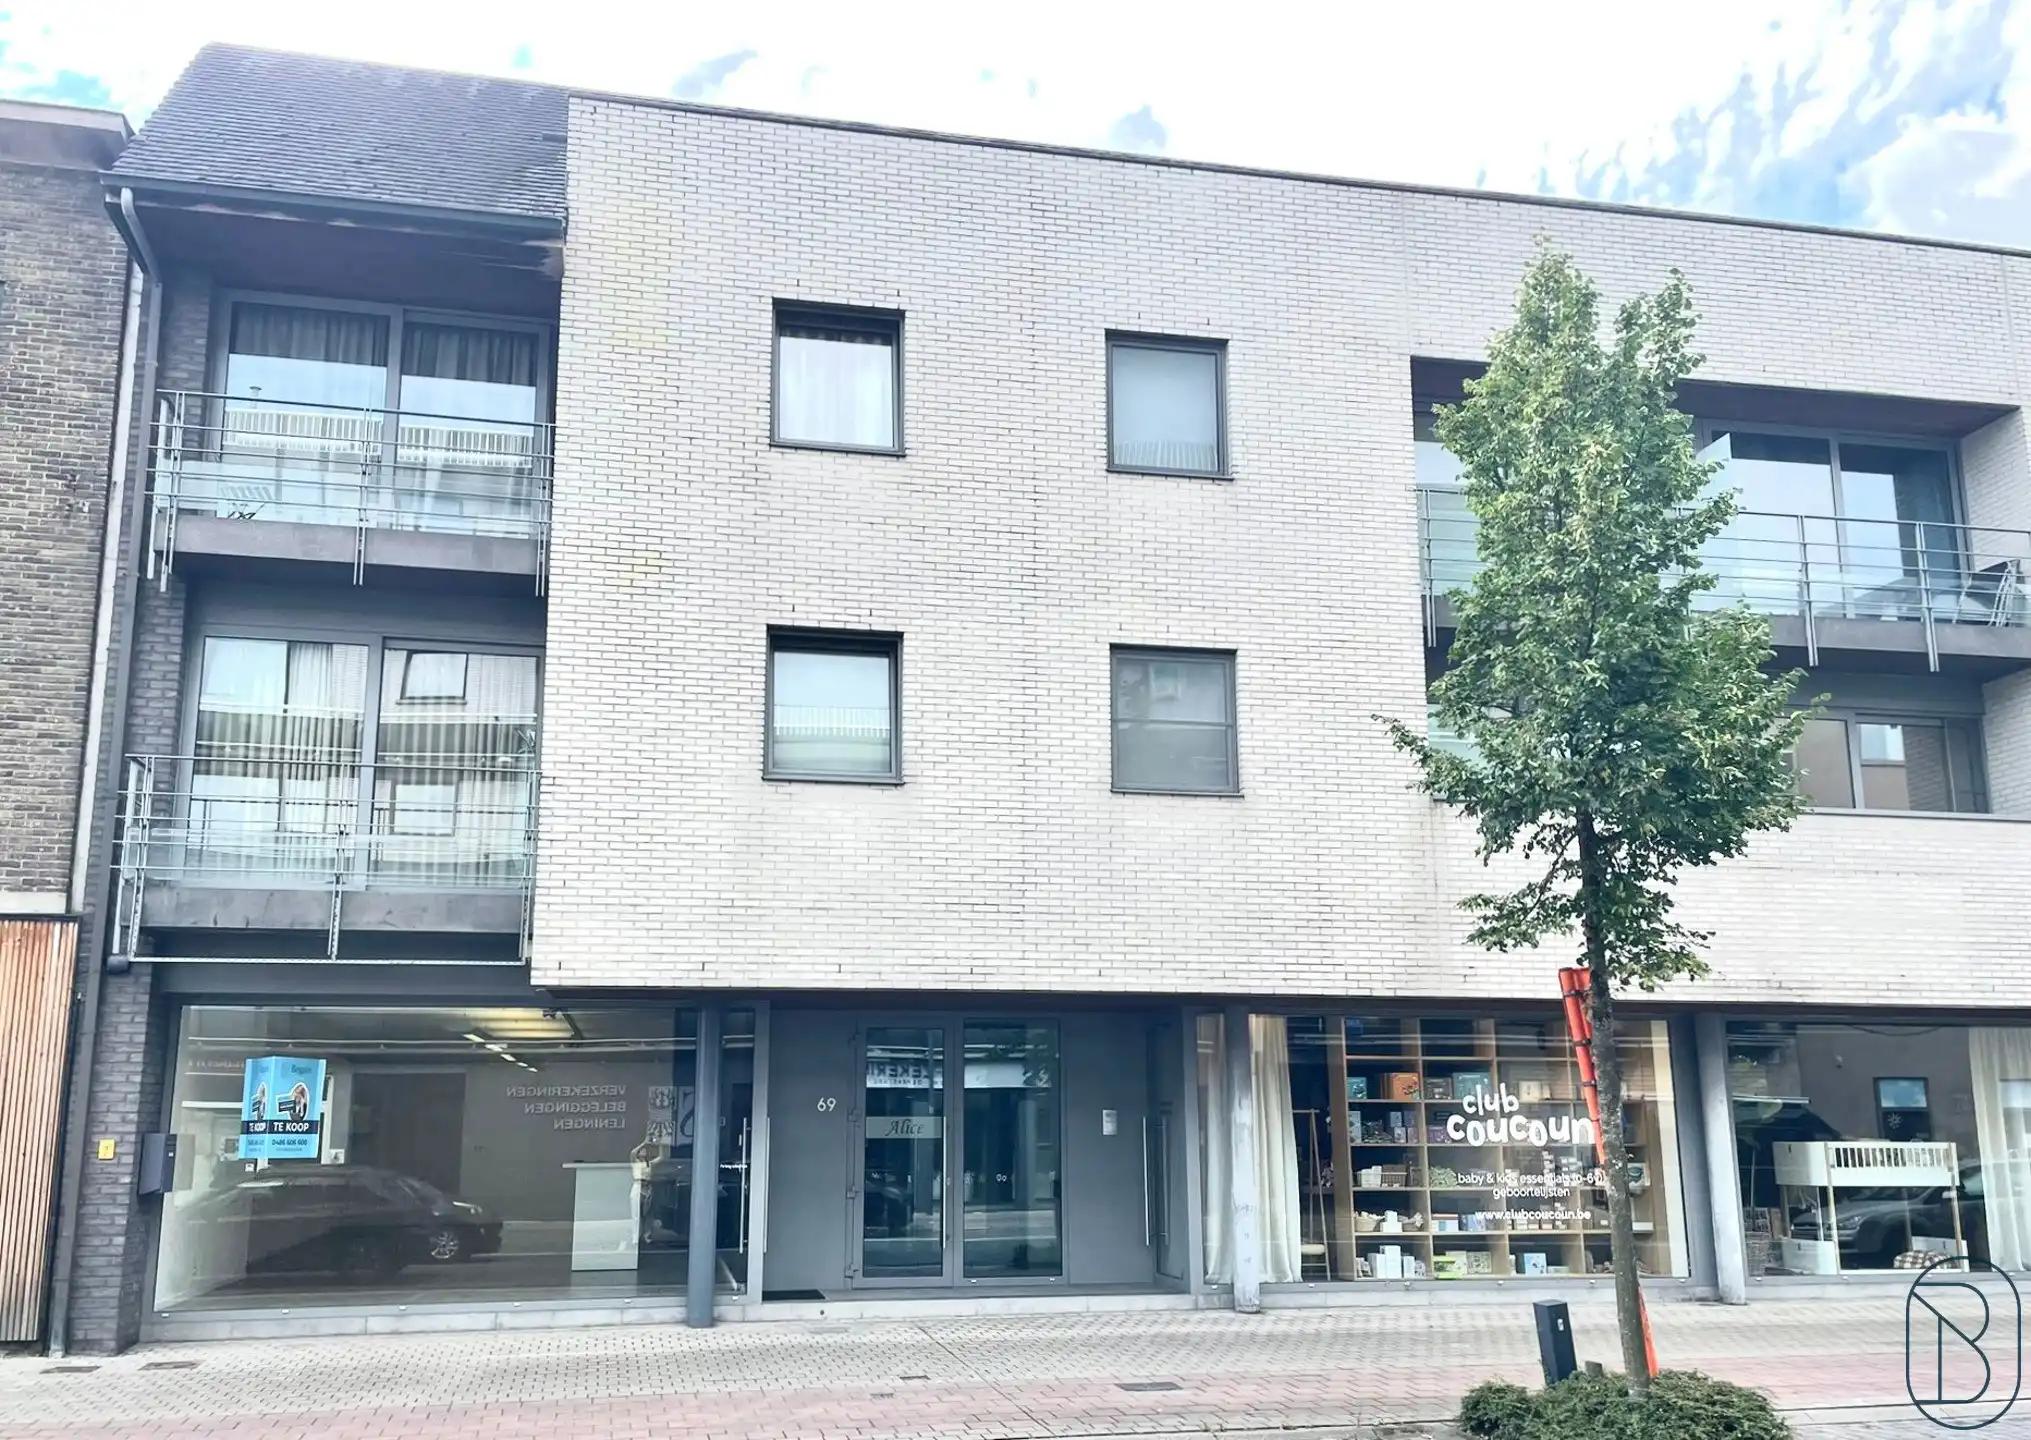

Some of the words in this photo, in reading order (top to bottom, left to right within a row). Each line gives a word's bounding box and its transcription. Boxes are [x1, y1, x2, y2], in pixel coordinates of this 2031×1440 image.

[816, 1097, 837, 1112] 69
[1462, 1082, 1520, 1116] club
[273, 1122, 284, 1132] TE
[285, 1122, 309, 1132] KOOP
[884, 1118, 925, 1137] Alice
[1446, 1114, 1596, 1147] coucoun
[1457, 1172, 1484, 1186] baby
[1486, 1173, 1495, 1183] &
[1496, 1172, 1518, 1184] kids
[1519, 1173, 1571, 1185] essentials
[1492, 1187, 1571, 1199] geboortelijsten
[1475, 1208, 1592, 1220] www.clubcoucoun.be
